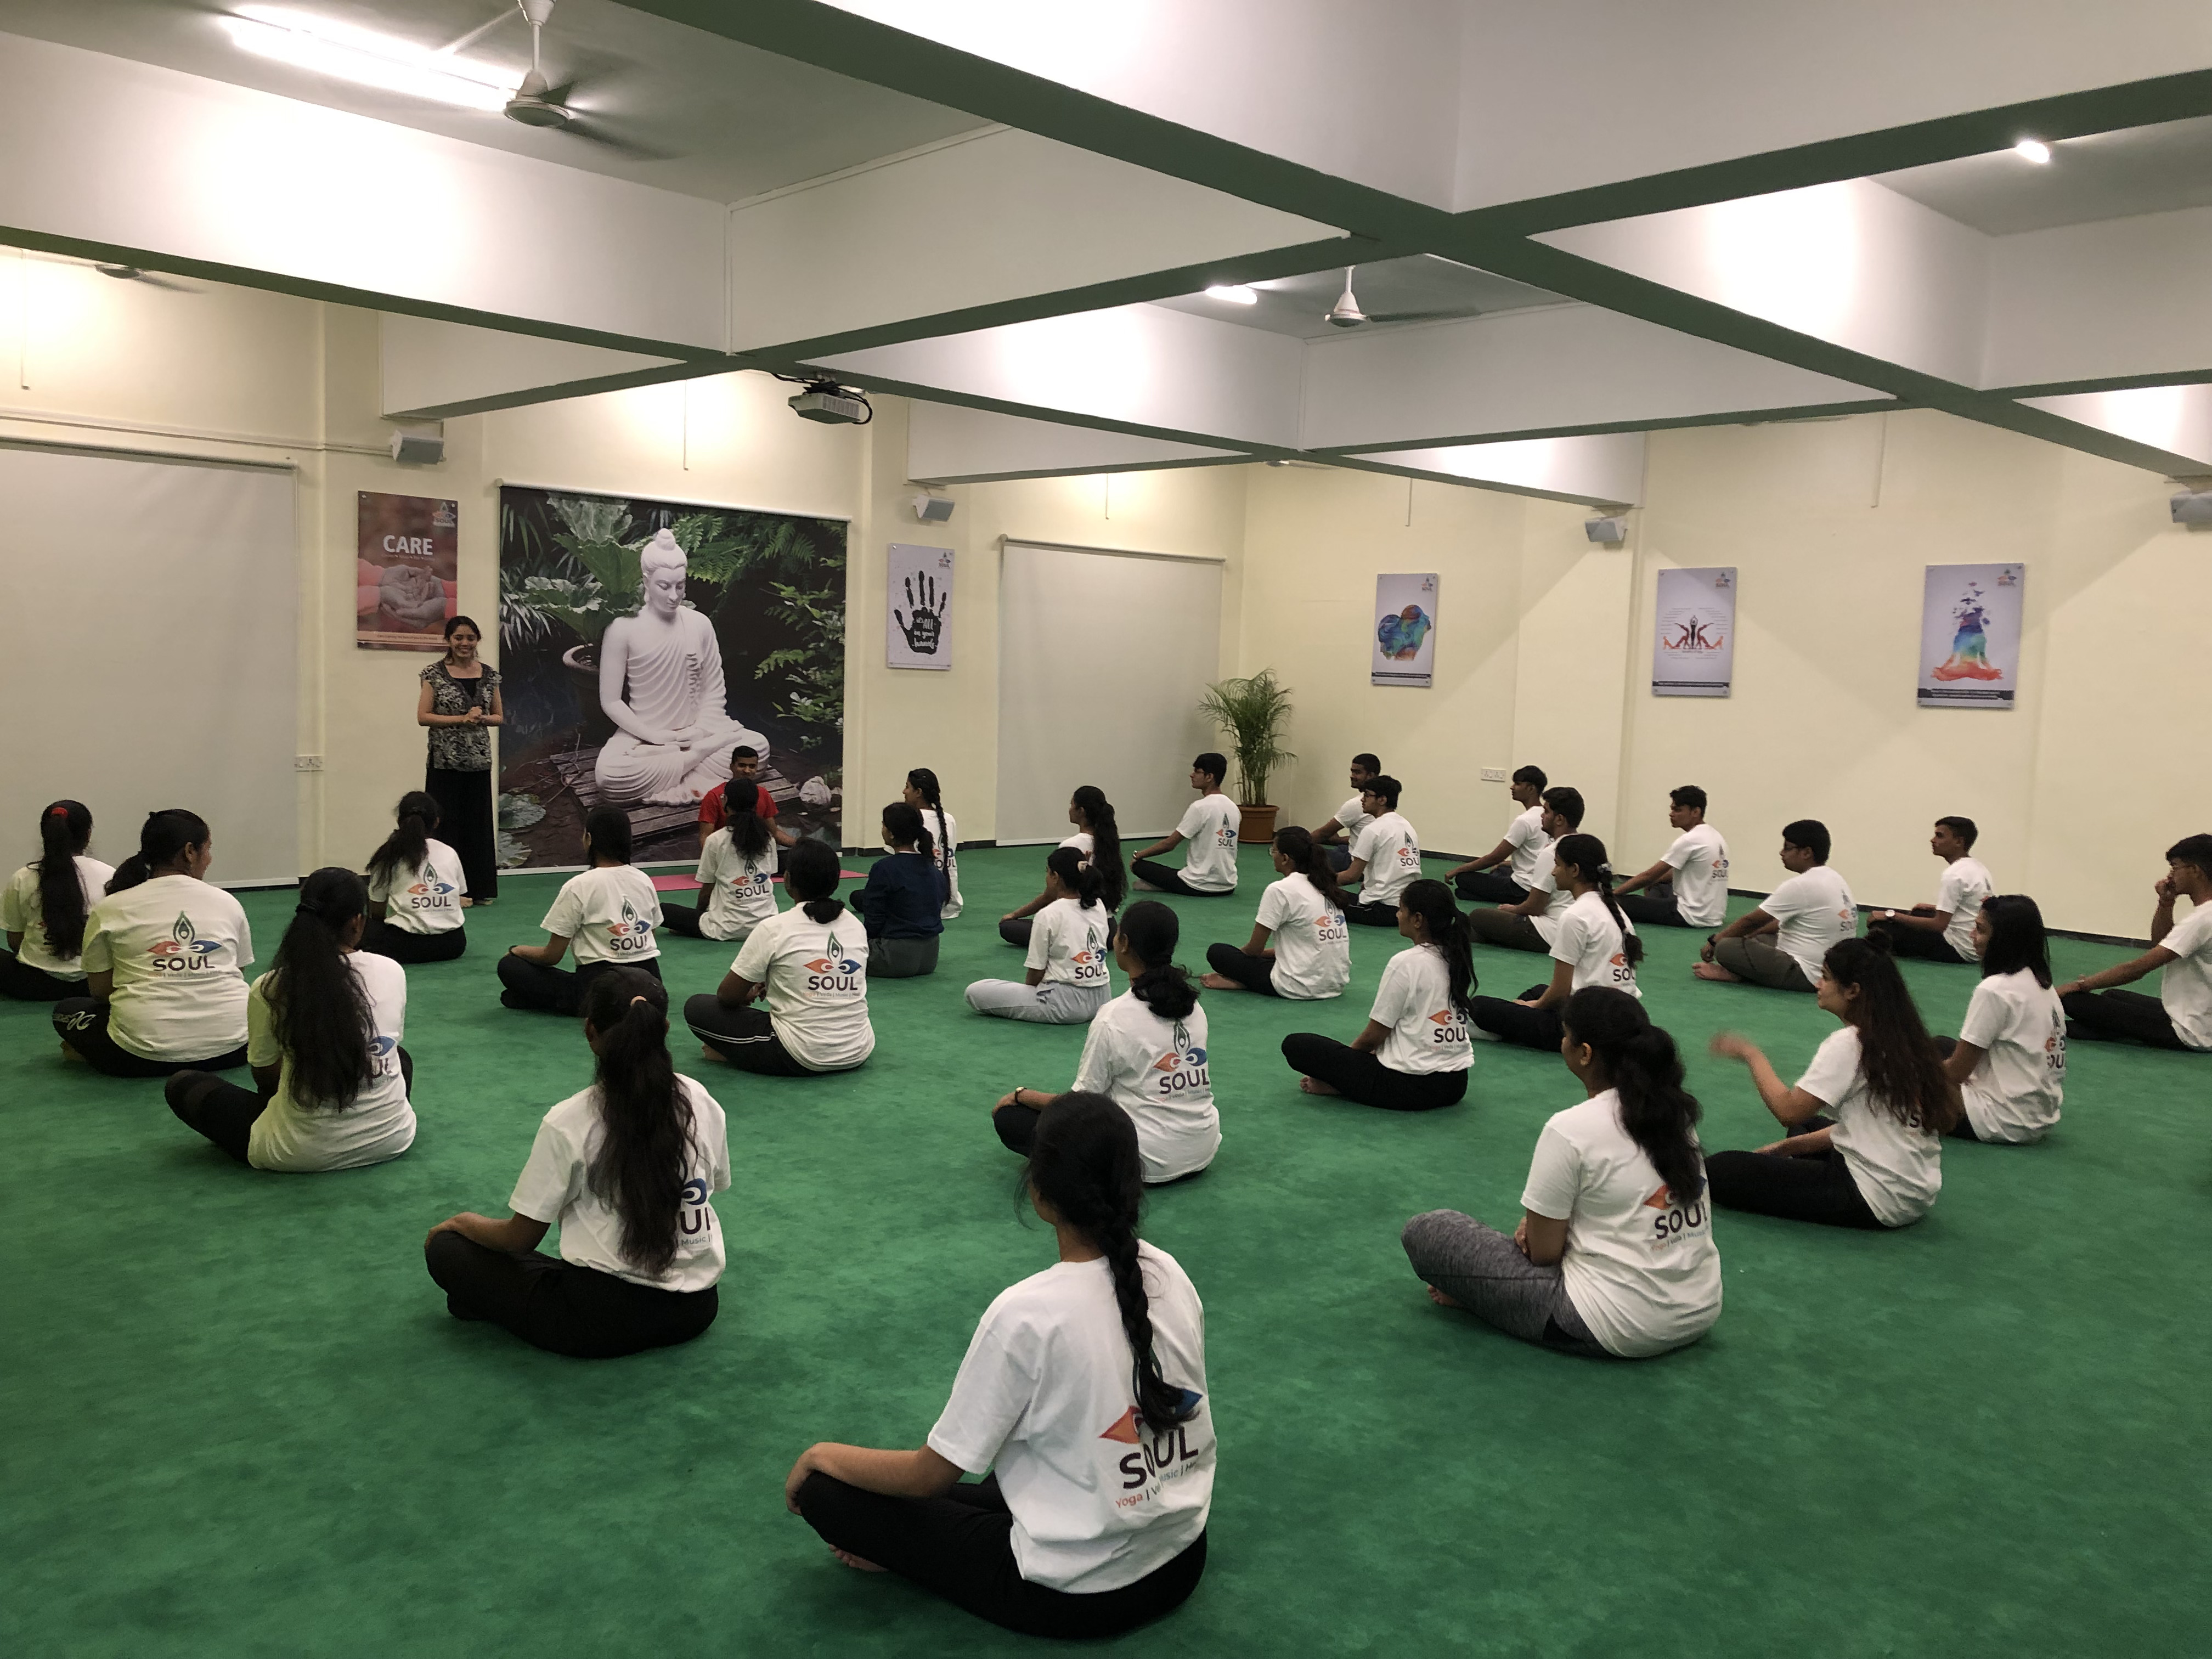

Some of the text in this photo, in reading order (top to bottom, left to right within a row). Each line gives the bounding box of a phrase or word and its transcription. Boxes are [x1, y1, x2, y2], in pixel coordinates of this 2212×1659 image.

[383, 535, 433, 555] CARE
[935, 859, 956, 868] OUL
[1400, 857, 1420, 867] SOU
[736, 884, 769, 899] SOUL
[411, 896, 451, 909] SOUL
[153, 955, 215, 971] SOUL
[808, 975, 858, 991] SOUL
[1434, 1026, 1467, 1043] SOU
[1159, 1068, 1210, 1094] SOUL
